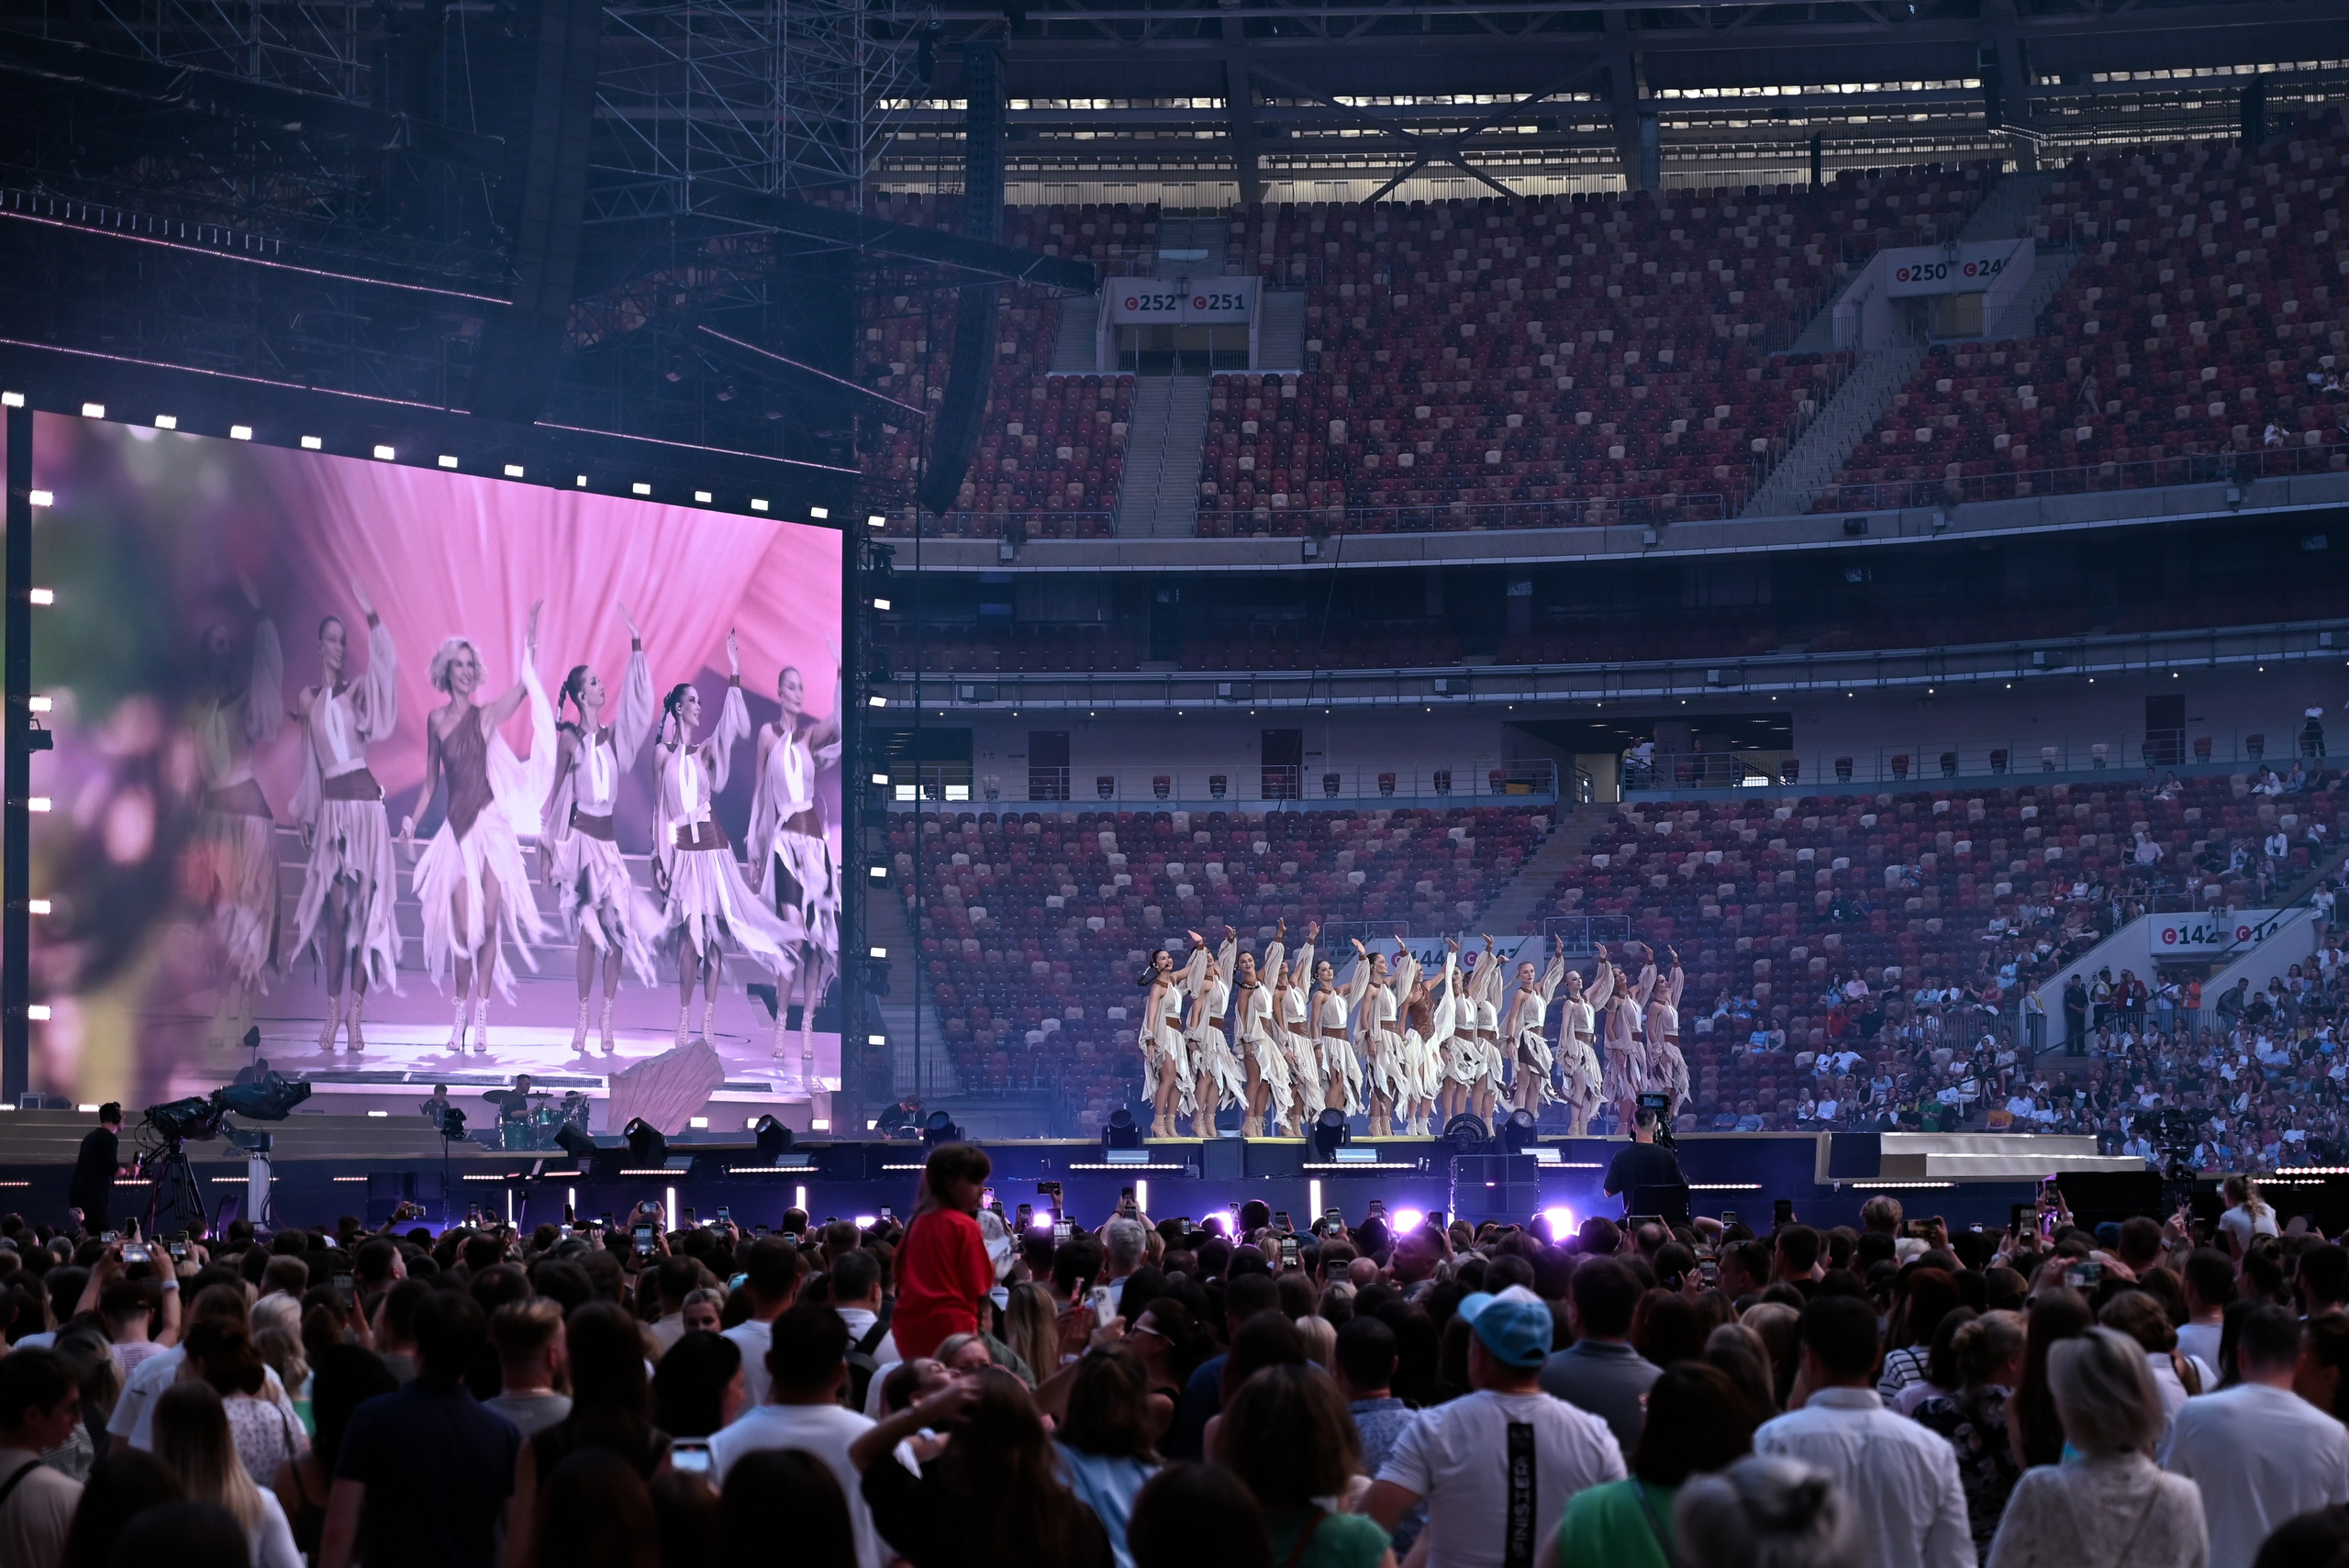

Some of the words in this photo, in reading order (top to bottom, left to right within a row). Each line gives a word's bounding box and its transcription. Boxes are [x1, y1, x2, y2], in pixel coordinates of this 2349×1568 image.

[1911, 263, 1947, 282] 250
[1979, 257, 2010, 276] 24
[1140, 295, 1176, 310] 252
[1208, 294, 1245, 310] 251
